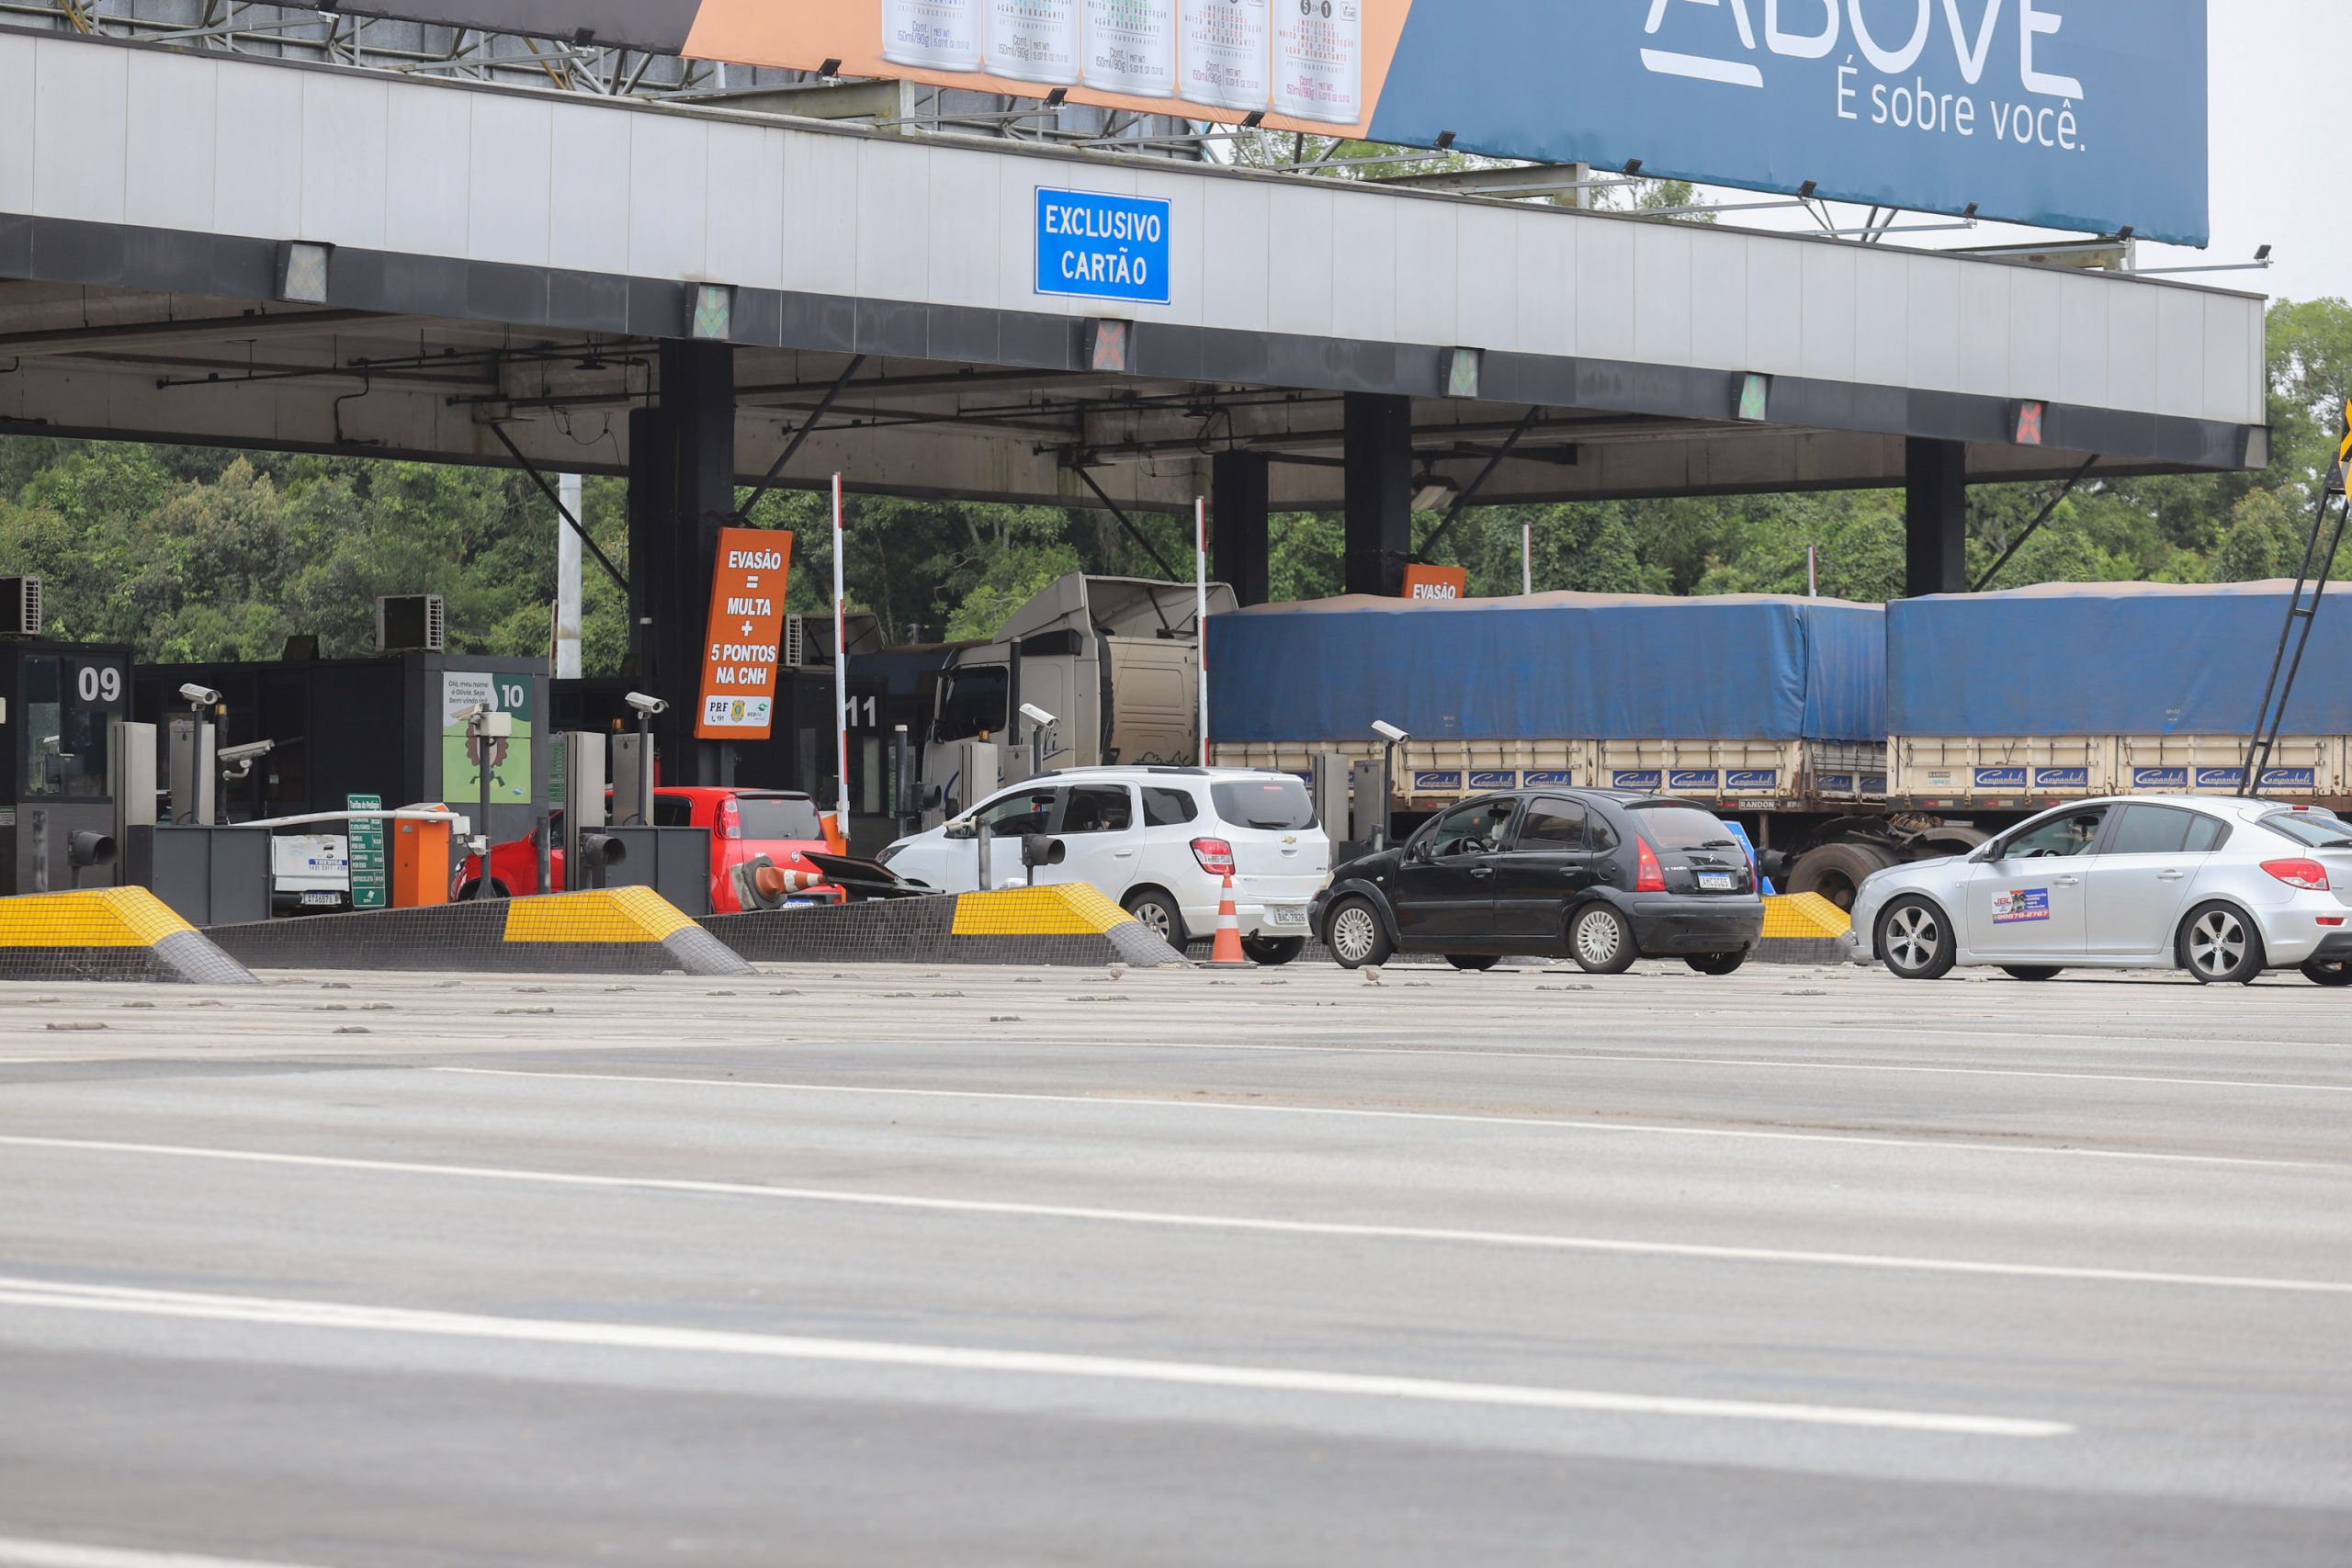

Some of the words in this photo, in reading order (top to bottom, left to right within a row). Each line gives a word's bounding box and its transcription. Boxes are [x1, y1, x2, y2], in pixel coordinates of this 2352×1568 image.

[1838, 53, 1858, 120] É
[1871, 76, 1974, 136] sobre
[1990, 97, 2086, 152] você.
[1046, 204, 1161, 243] EXCLUSIVO
[1061, 246, 1148, 286] CARTÃO
[729, 548, 782, 570] EVASÃO
[1413, 581, 1456, 600] EVASÃO
[727, 597, 772, 616] MULTA
[710, 644, 720, 661] 5
[722, 644, 777, 663] PONTOS
[78, 666, 121, 702] 09
[716, 666, 736, 685] NA
[739, 667, 769, 685] CNH
[502, 684, 525, 707] 10
[709, 702, 729, 712] PRF
[845, 695, 876, 727] 11
[2198, 770, 2243, 785] Campanh
